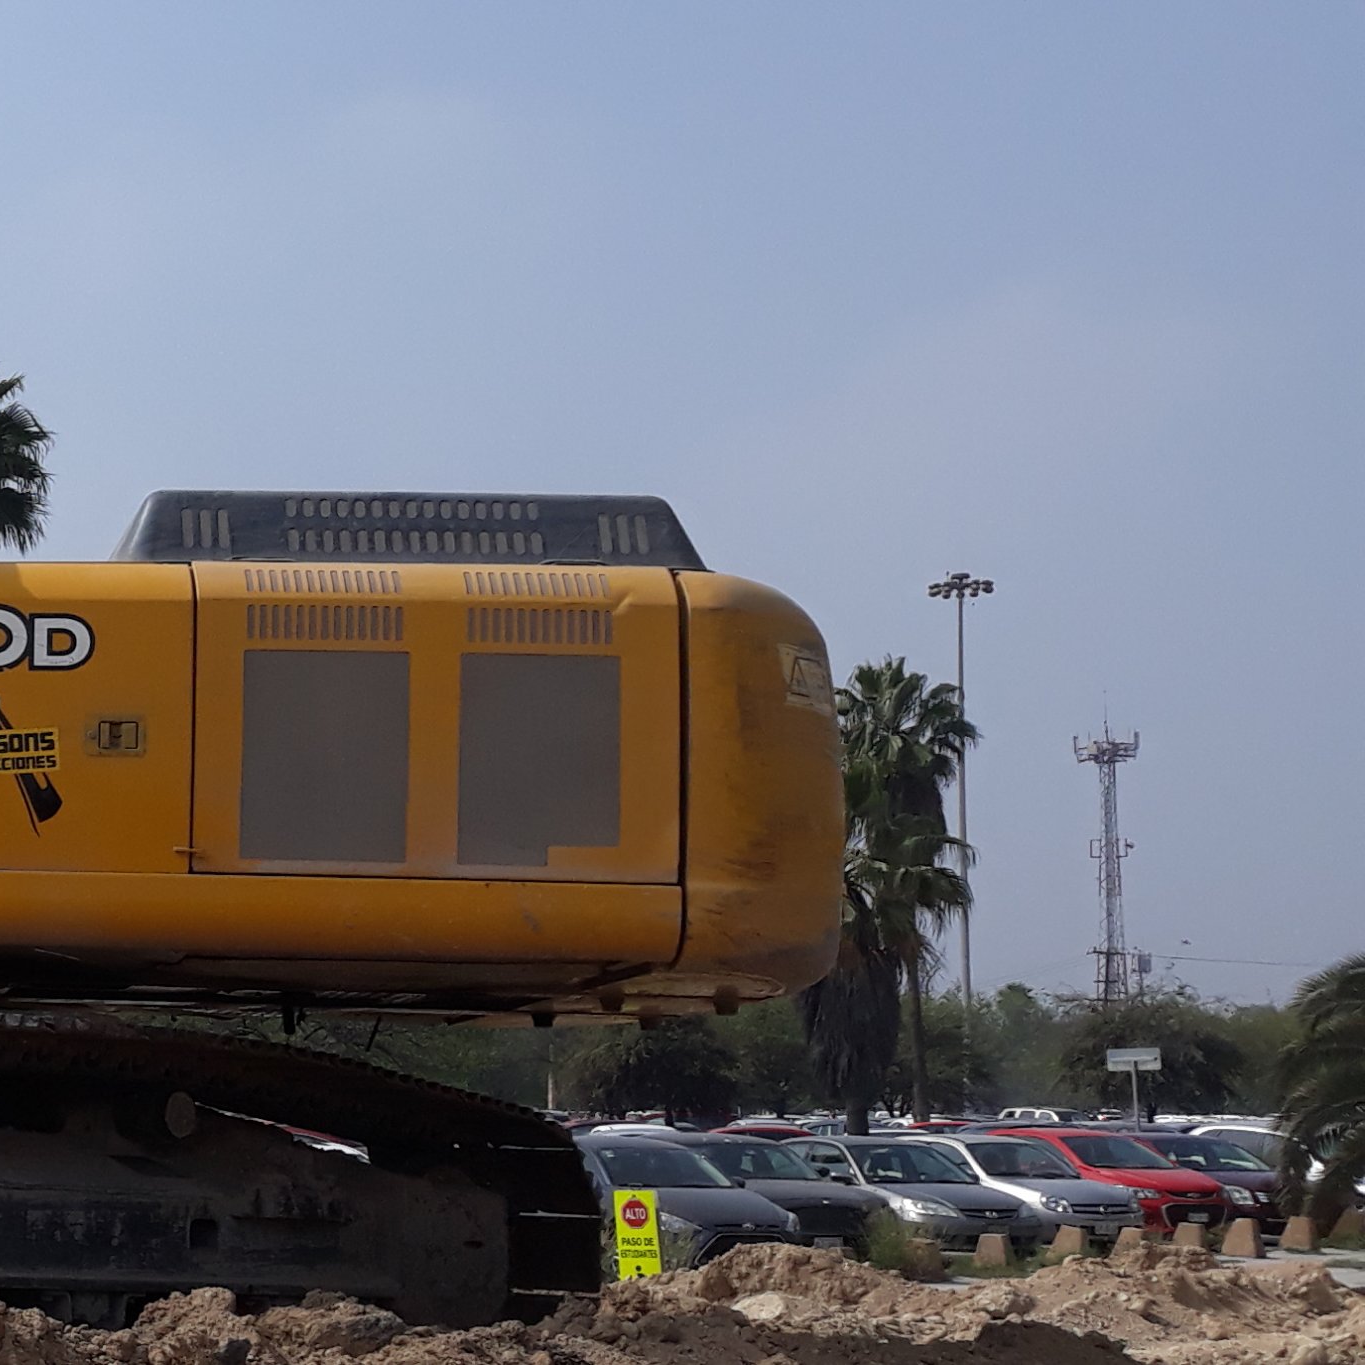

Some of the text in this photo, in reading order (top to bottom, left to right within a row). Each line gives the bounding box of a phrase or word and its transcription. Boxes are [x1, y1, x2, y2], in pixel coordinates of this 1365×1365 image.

[625, 1208, 646, 1219] ALTO
[621, 1237, 655, 1246] PASO DE
